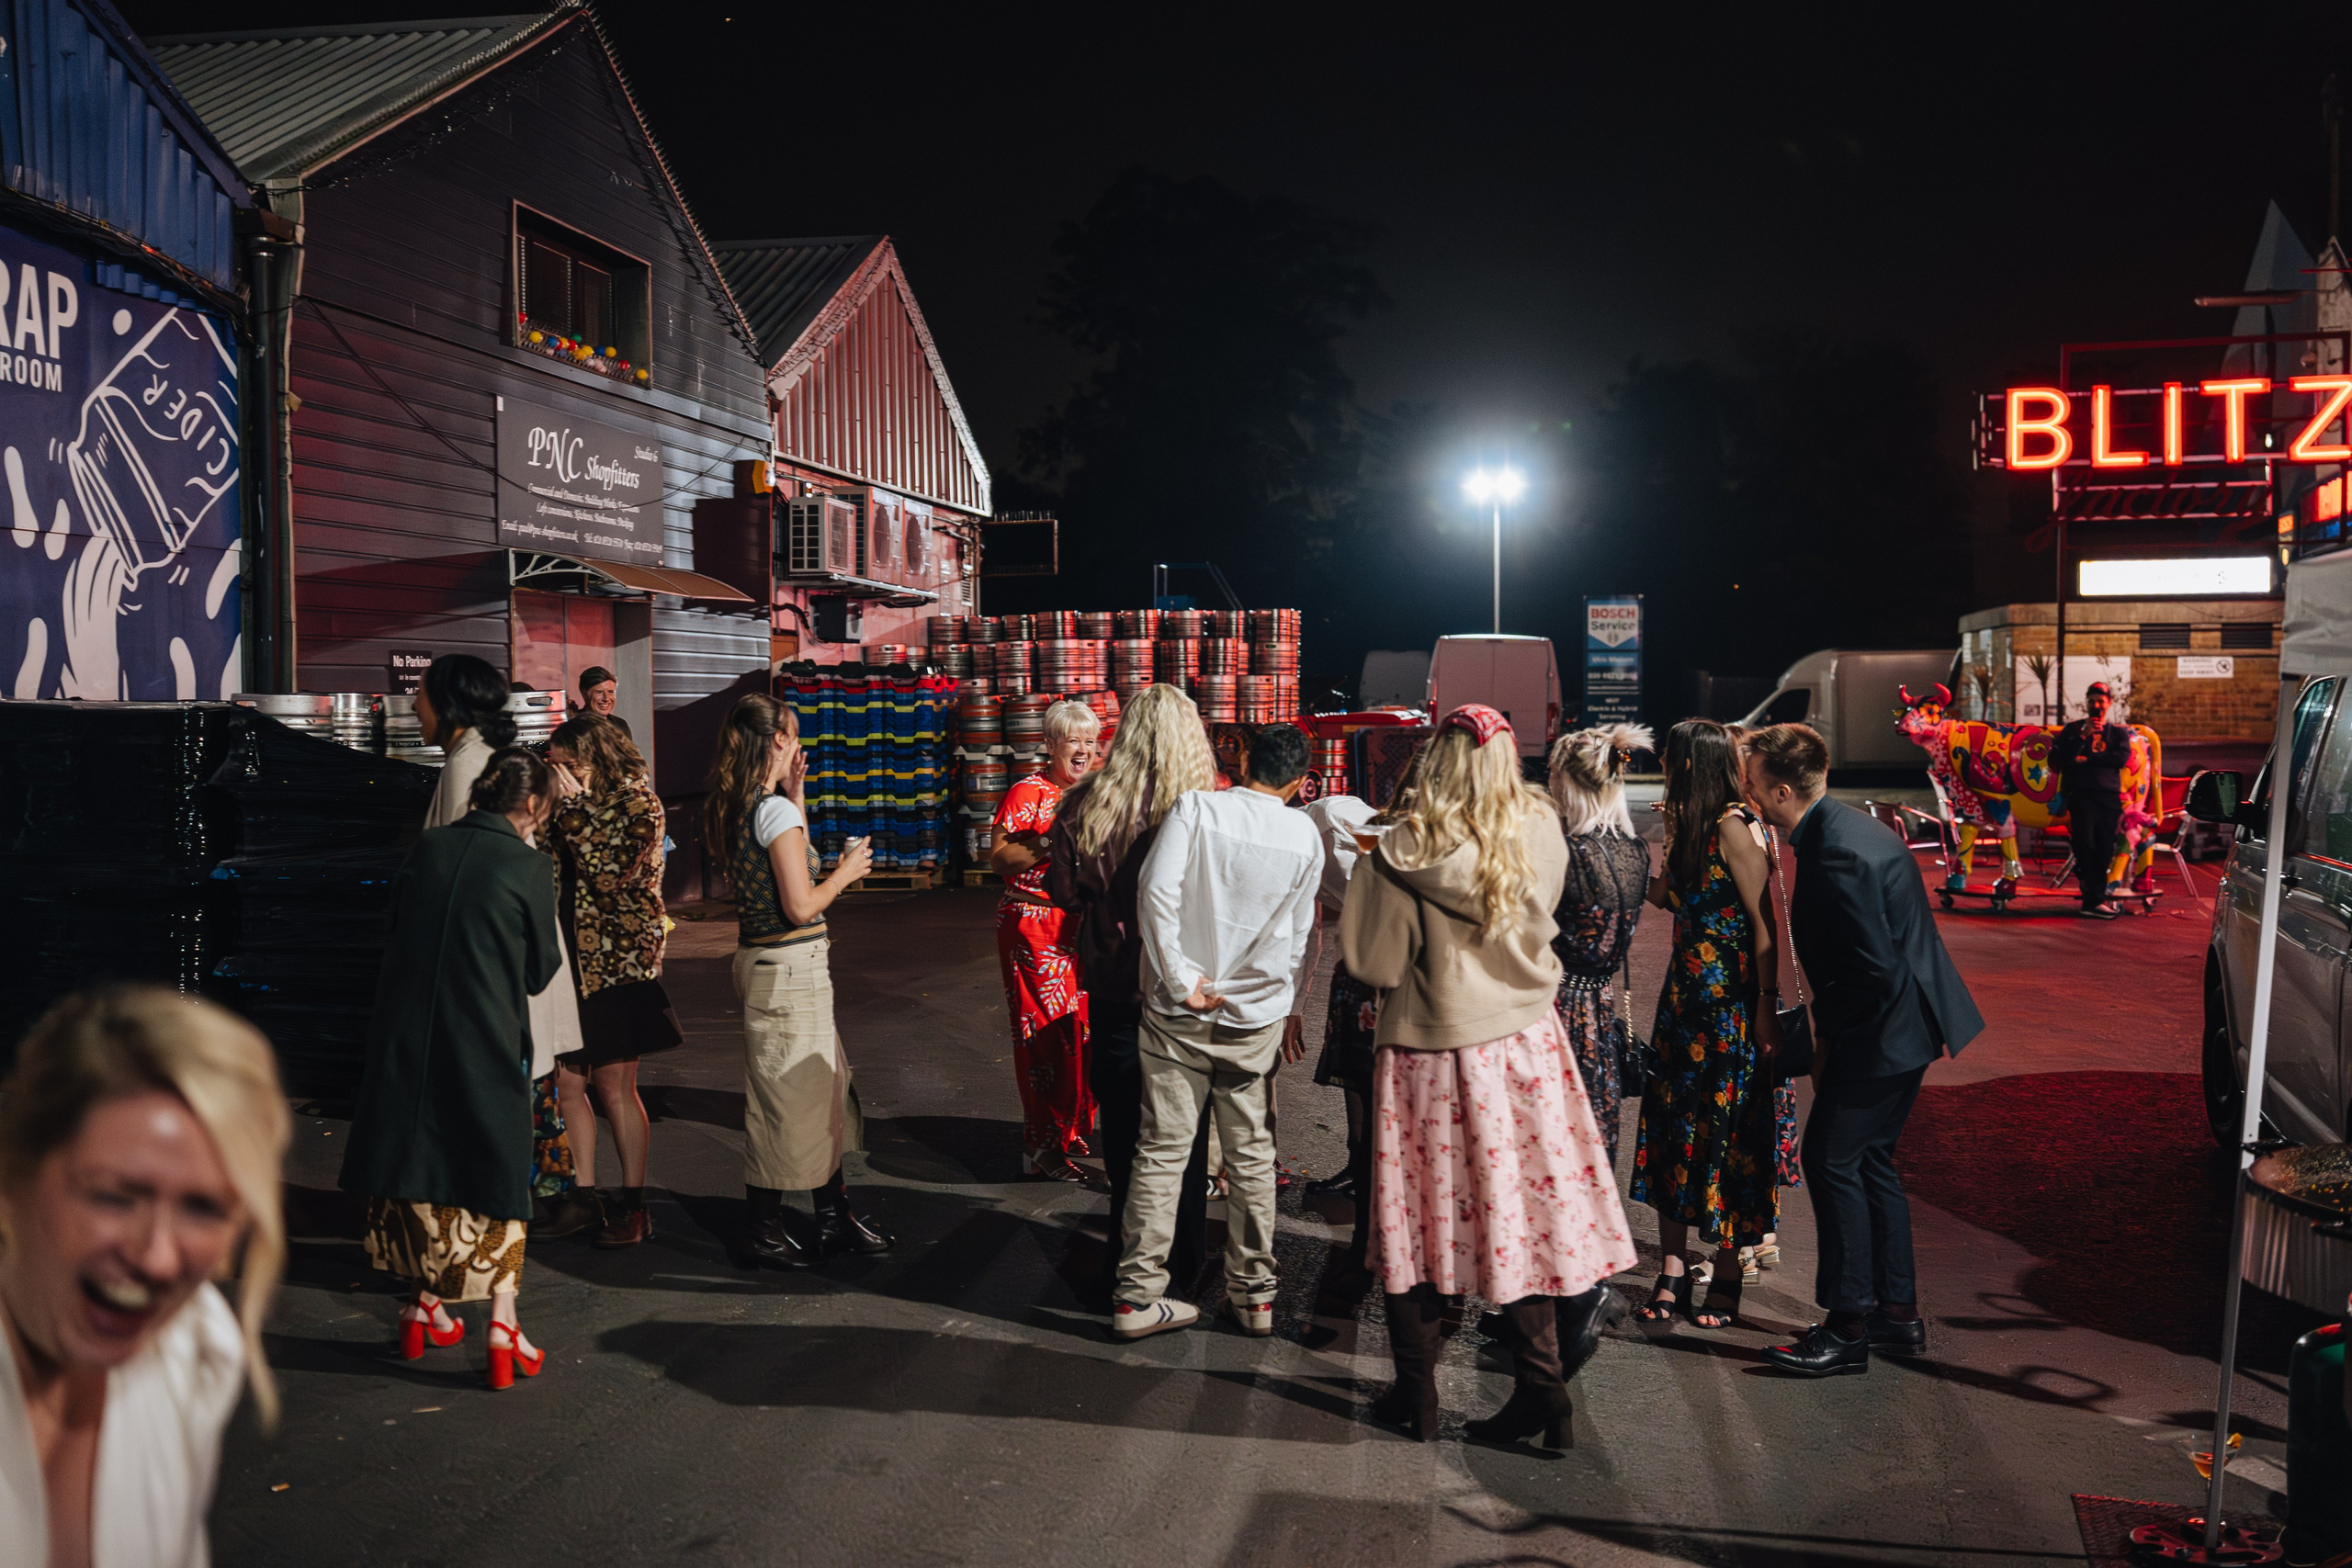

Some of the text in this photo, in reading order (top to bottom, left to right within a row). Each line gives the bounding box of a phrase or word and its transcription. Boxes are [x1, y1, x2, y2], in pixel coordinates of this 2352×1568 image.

[0, 351, 62, 393] ROOM
[143, 374, 230, 476] CIDER
[2006, 374, 2352, 471] BLITZ
[527, 426, 640, 491] PNC Shopfitters
[1590, 608, 1635, 619] BOSCH
[1590, 621, 1635, 631] Service
[392, 655, 404, 667] No
